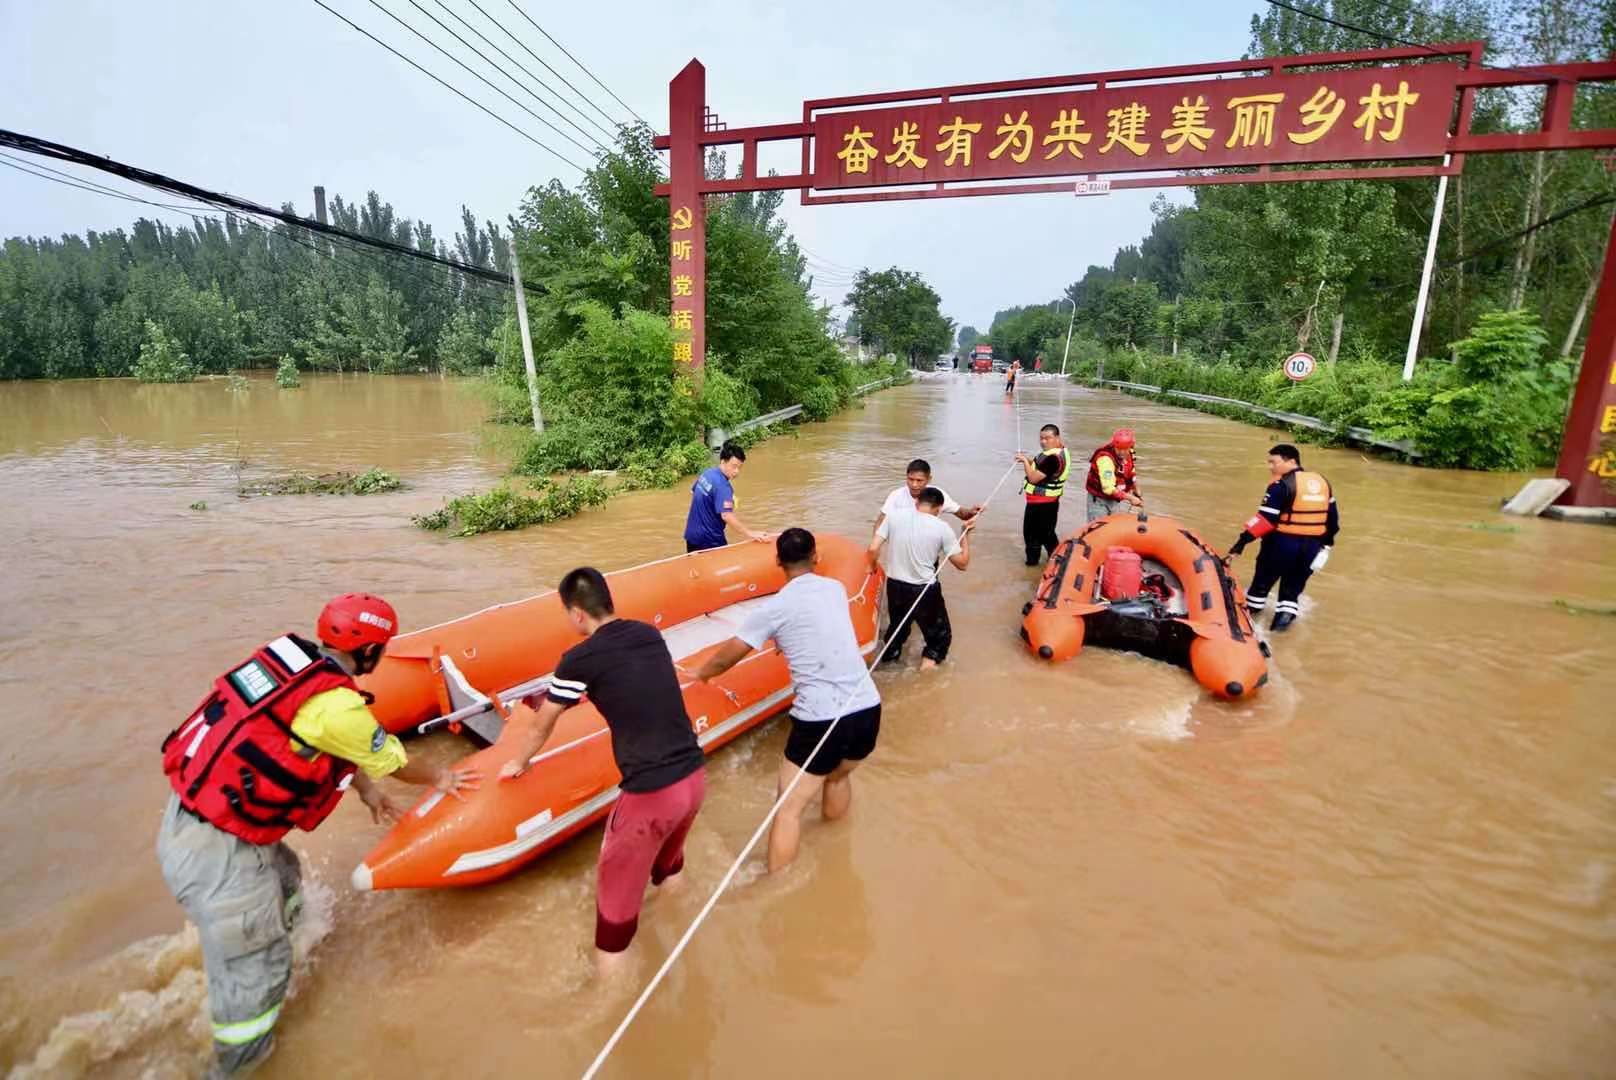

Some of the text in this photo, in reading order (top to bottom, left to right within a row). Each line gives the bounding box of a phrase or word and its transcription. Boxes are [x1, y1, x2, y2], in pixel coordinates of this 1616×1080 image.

[837, 81, 1420, 174] 奋发有为共建美丽乡村
